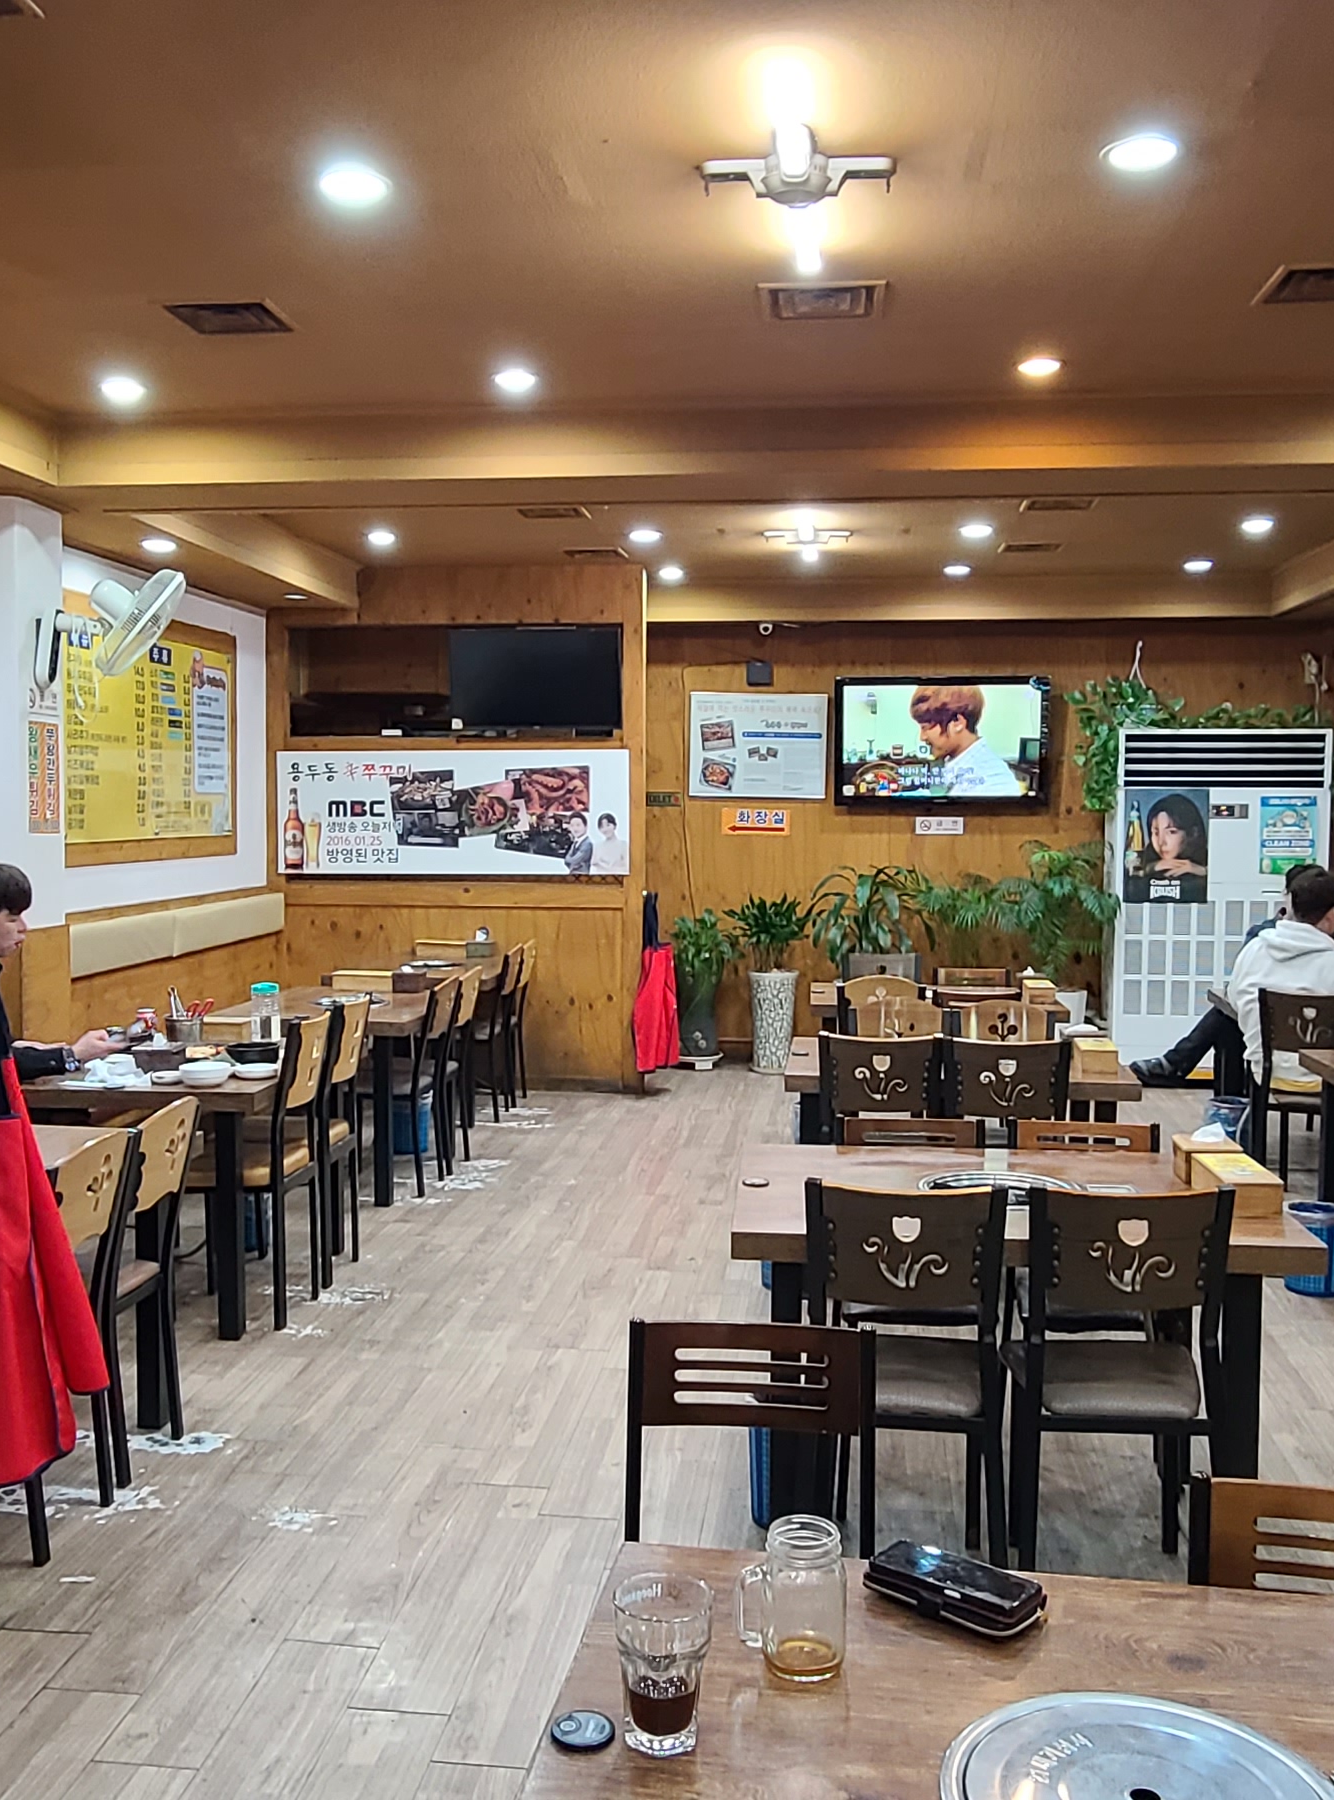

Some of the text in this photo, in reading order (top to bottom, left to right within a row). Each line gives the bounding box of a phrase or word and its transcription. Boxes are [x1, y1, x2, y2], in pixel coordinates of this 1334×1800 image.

[287, 762, 338, 782] 용두동
[328, 800, 385, 817] MBC
[326, 822, 358, 833] 생방송
[326, 836, 383, 847] 2016.01.25
[327, 848, 398, 863] 방영된 맛집
[1150, 886, 1180, 899] KRUSH
